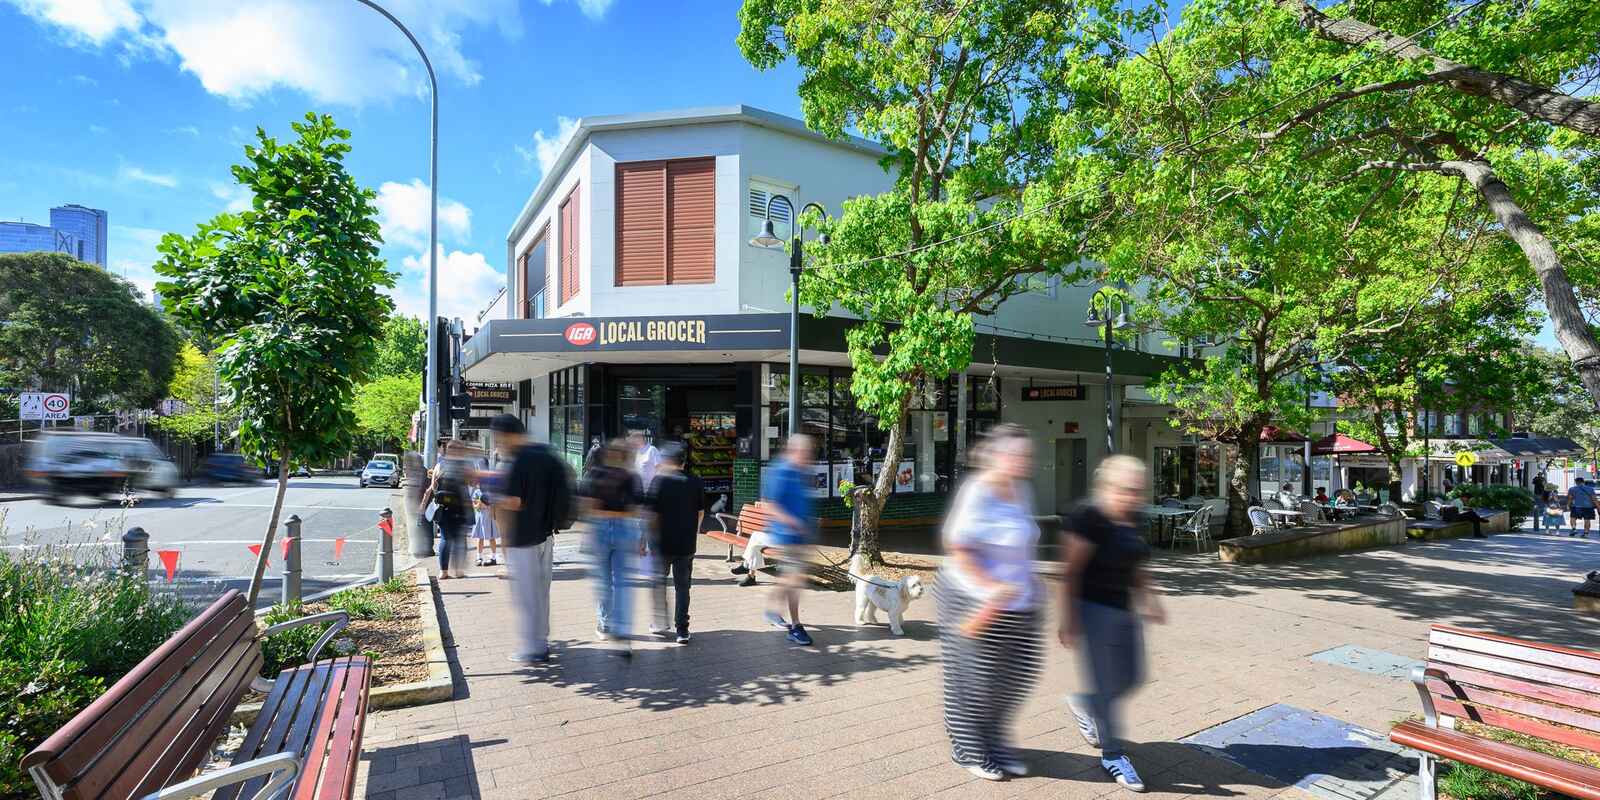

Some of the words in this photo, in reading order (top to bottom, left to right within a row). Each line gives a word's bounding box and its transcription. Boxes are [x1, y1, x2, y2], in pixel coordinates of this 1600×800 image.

[568, 327, 593, 341] IGA
[600, 321, 644, 345] LOCAL
[647, 320, 705, 344] GROCER
